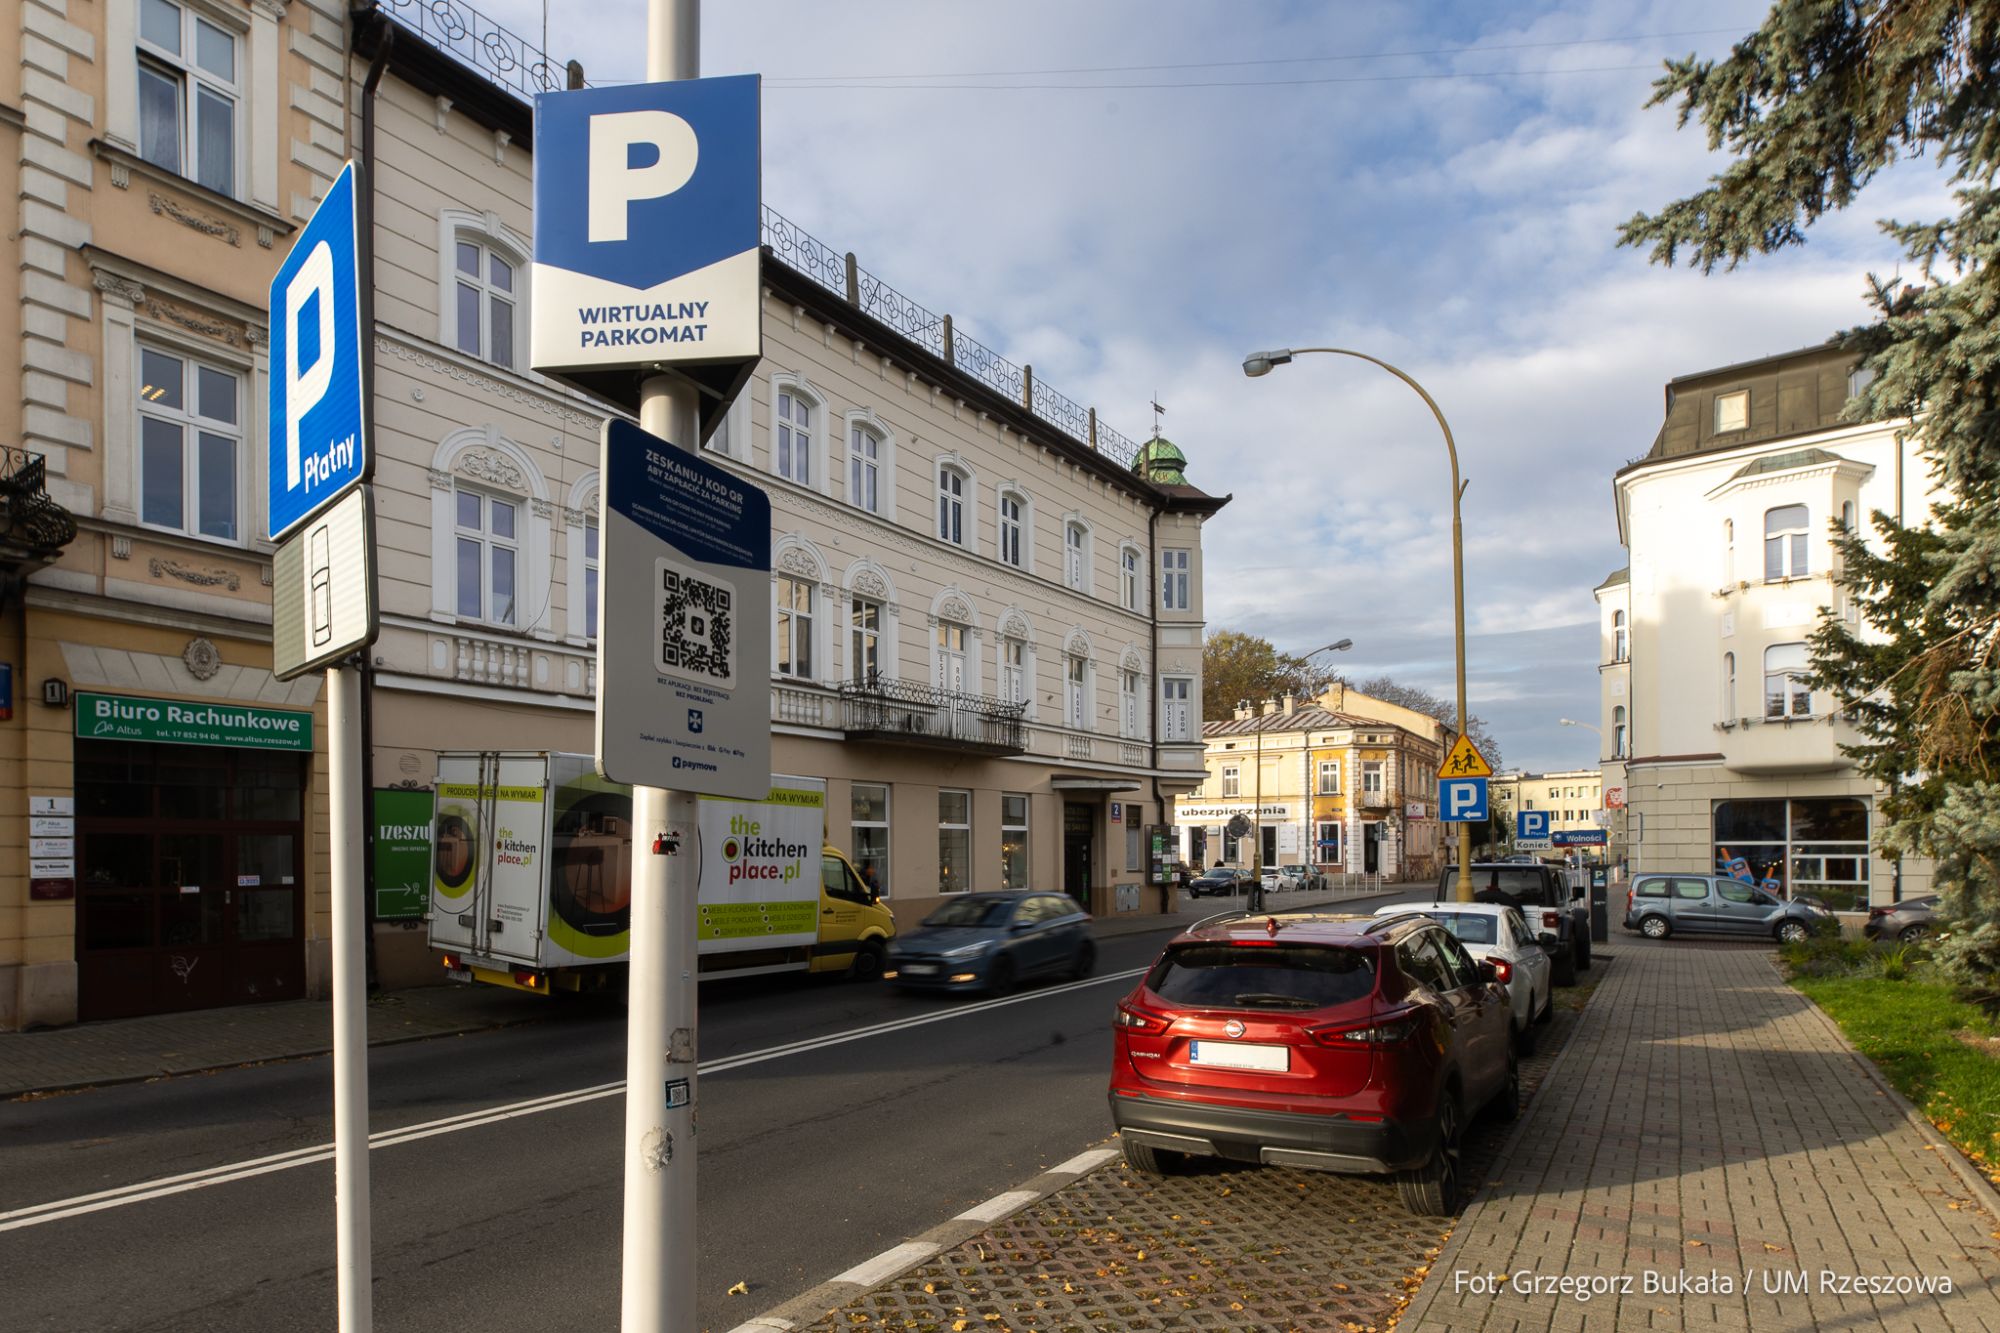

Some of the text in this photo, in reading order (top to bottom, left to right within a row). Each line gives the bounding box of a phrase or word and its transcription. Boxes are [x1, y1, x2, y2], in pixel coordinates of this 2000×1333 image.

[588, 110, 699, 242] P
[578, 301, 709, 325] WIRTUALNY
[580, 324, 708, 348] PARKOMAT
[286, 239, 335, 492] P
[304, 432, 355, 495] Płatny
[645, 448, 703, 485] ZESKANUJ
[705, 477, 728, 496] KOD
[729, 489, 744, 505] QR
[647, 464, 743, 514] ABY ZAPŁACIĆ ZA PARKING
[95, 700, 300, 733] Biuro Rachunkowe
[116, 724, 142, 736] Altus
[156, 729, 171, 737] tel.
[172, 730, 182, 738] 17
[184, 731, 198, 739] 852
[199, 732, 209, 740] 94
[225, 734, 301, 746] www.altus.rzeszow.pl
[682, 759, 717, 771] paymove
[446, 787, 480, 797] PRODUCEN
[500, 790, 509, 798] NA
[510, 790, 536, 799] WYMIAR
[776, 793, 787, 802] NA
[789, 793, 819, 804] WYMIAR
[1450, 783, 1477, 817] P
[48, 799, 56, 809] 1
[1114, 804, 1119, 815] 2
[498, 827, 513, 839] the
[729, 814, 761, 836] the
[1524, 814, 1543, 836] P
[504, 839, 536, 854] kitchen
[743, 836, 807, 858] kitchen
[1516, 841, 1549, 849] Koniec
[1566, 833, 1602, 843] Wolności
[497, 852, 532, 868] place.pl
[729, 859, 800, 885] place.pl
[1595, 870, 1604, 879] P
